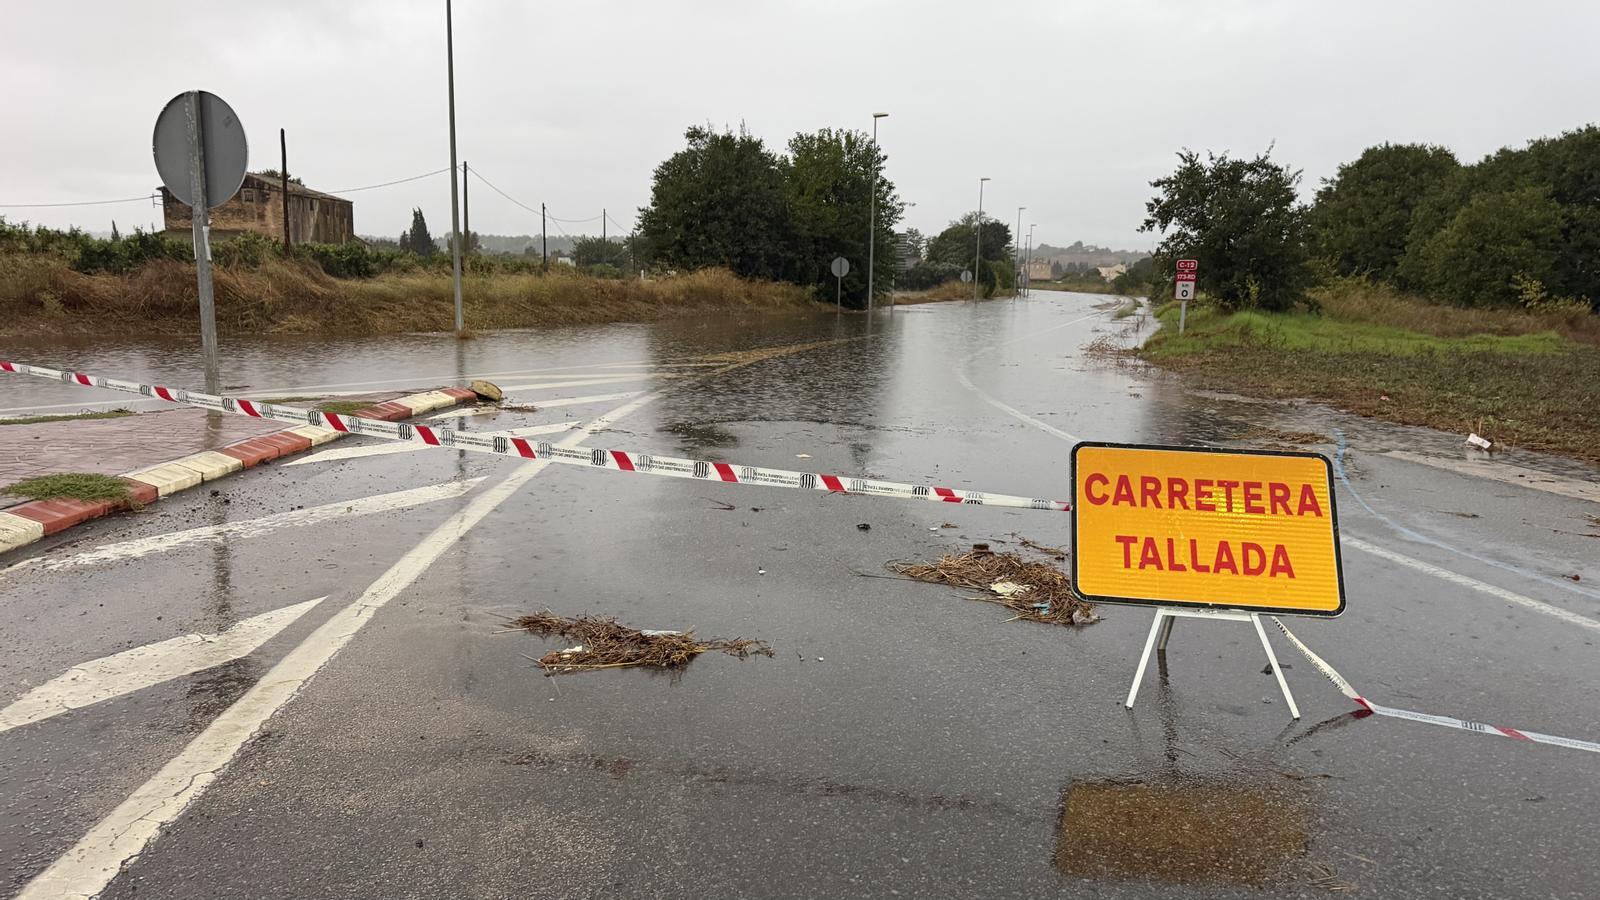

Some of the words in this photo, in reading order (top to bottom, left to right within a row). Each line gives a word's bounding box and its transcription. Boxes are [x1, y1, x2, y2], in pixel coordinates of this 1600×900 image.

[1182, 289, 1188, 297] 0
[1084, 472, 1323, 517] CARRETERA
[1115, 535, 1296, 579] TALLADA
